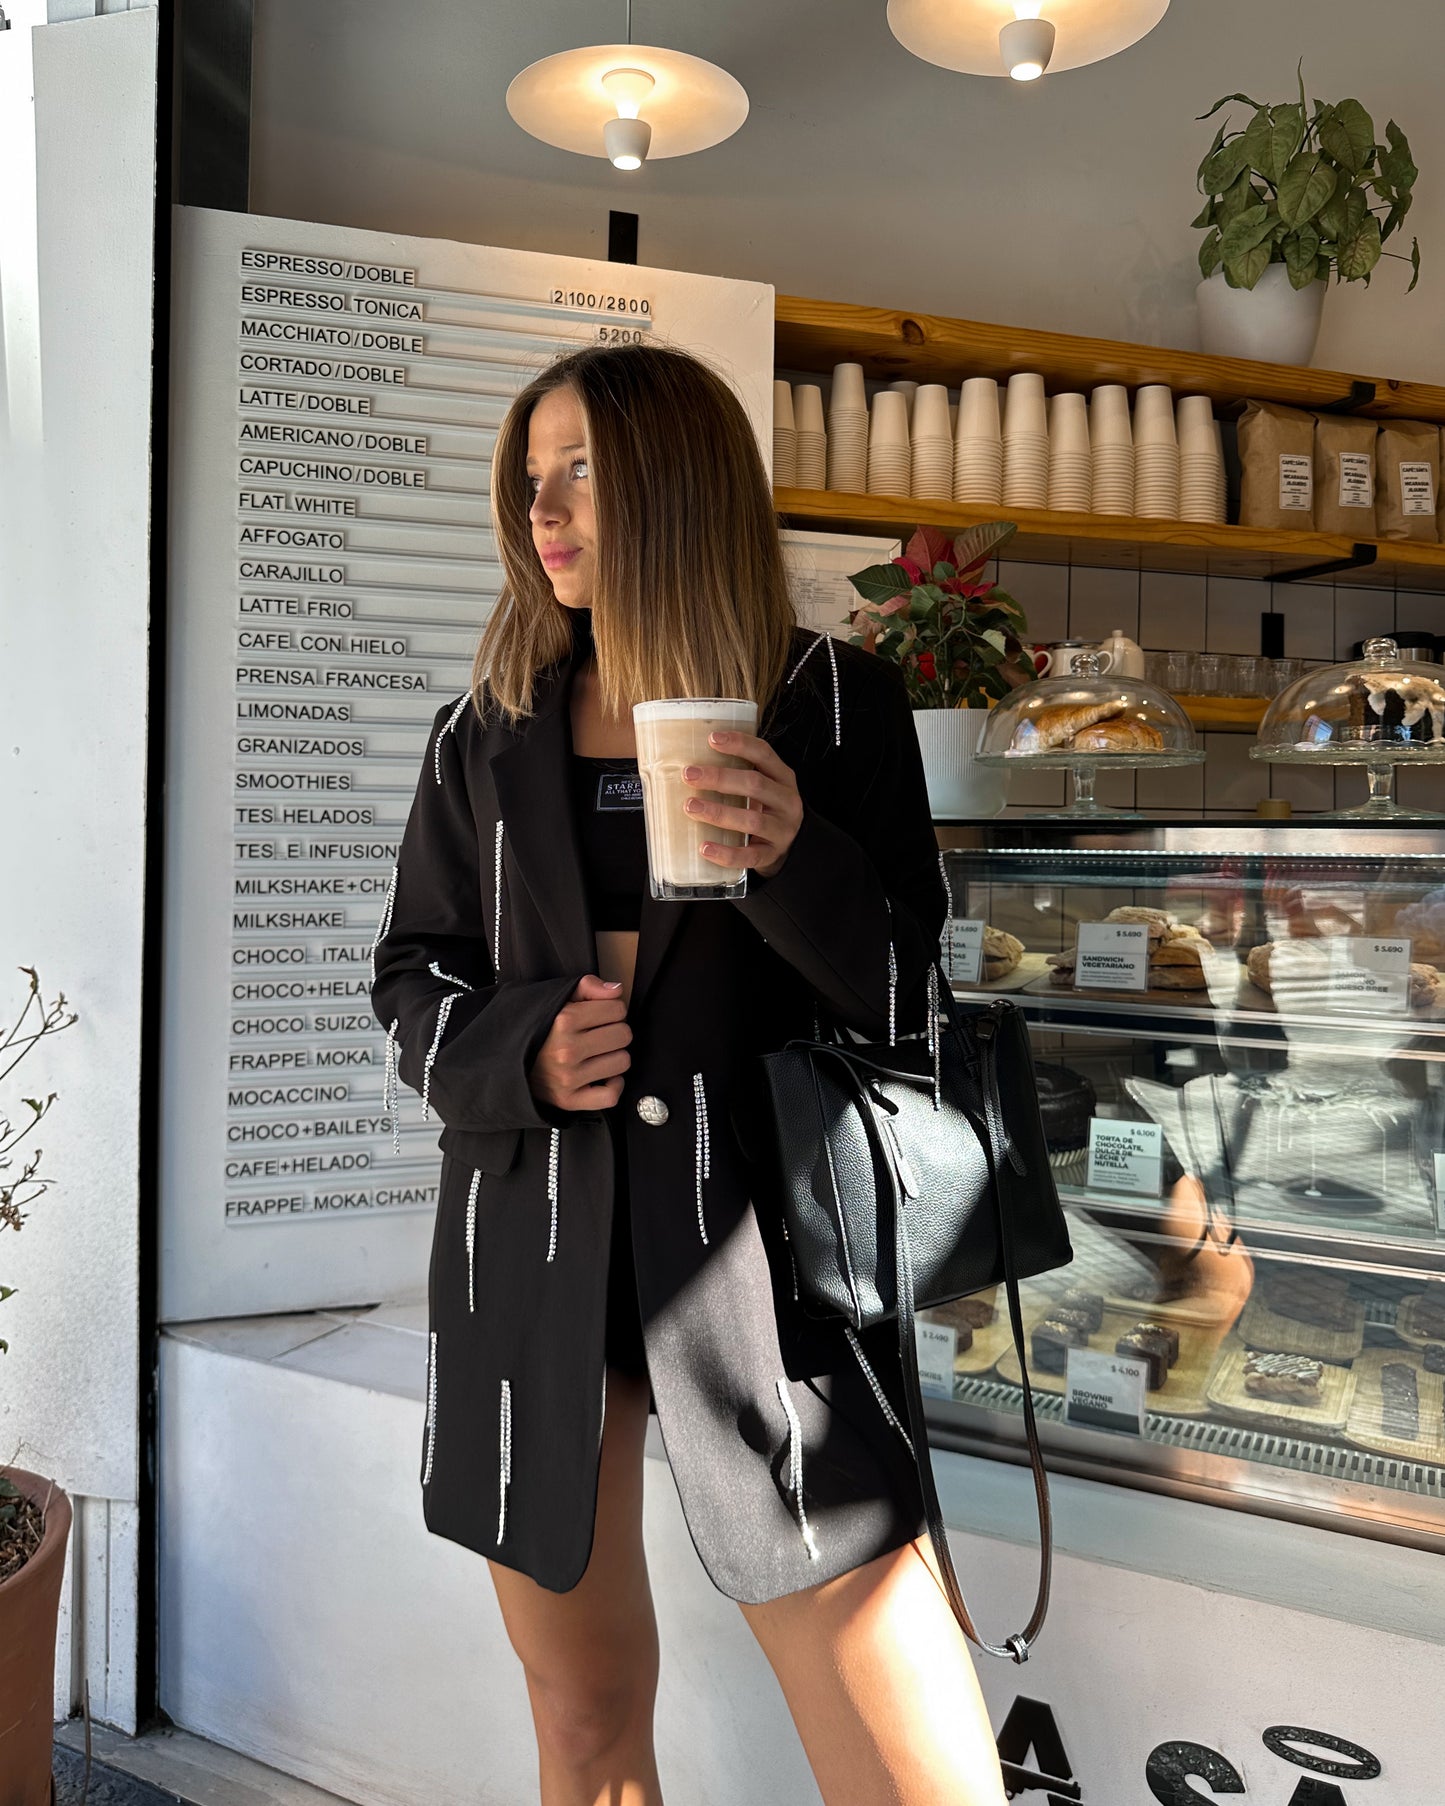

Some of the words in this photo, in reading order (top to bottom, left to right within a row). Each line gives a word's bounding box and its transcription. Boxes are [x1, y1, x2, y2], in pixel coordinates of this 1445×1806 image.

[241, 252, 414, 285] ESPRESSO/DOBLE
[241, 286, 343, 310] ESPRESSO
[353, 298, 421, 319] TONICA
[554, 290, 649, 313] 2100/2800
[241, 321, 422, 353] MACCHIATO/DOBLE
[600, 328, 641, 344] 5200
[241, 355, 404, 384] CORTADO/DOBLE
[240, 389, 369, 414] LATTE/DOBLE
[241, 424, 426, 454] AMERICANO/DOBLE
[240, 459, 424, 488] CAPUCHINO/DOBLE
[239, 493, 284, 510] FLAT
[295, 498, 355, 515] WHITE
[240, 528, 342, 548] AFFOGATO
[240, 563, 342, 583] CARAJILLO
[240, 598, 297, 614] LATTE
[308, 601, 351, 617] FRIO
[239, 633, 289, 649] CAFE
[301, 636, 341, 651] CON
[351, 639, 404, 655] HIELO
[237, 668, 315, 685] PRENSA
[326, 672, 425, 690] FRANCESA
[238, 703, 349, 720] LIMONADAS
[238, 738, 363, 756] GRANIZADOS
[236, 773, 350, 790] SMOOTHIES
[236, 808, 273, 823] TES
[283, 809, 372, 825] HELADOS
[236, 844, 273, 859] TES
[288, 844, 299, 858] E
[310, 844, 400, 859] INFUSION
[234, 913, 343, 928] MILKSHAKE
[233, 949, 304, 964] CHOCO
[233, 981, 372, 999] CHOCO+HELA
[233, 1018, 304, 1035] CHOCO
[314, 1015, 371, 1031] SUIZO
[230, 1052, 306, 1070] FRAPPE
[317, 1050, 371, 1065] MOKA
[228, 1086, 347, 1106] MOCACCINO
[228, 1118, 391, 1141] CHOCO+BAILEYS
[1096, 1134, 1120, 1142] TORTA
[225, 1153, 369, 1178] CAFE+HELADO
[1094, 1160, 1128, 1169] NUTELLA
[225, 1197, 302, 1217] FRAPPE
[314, 1192, 369, 1209] MOKA
[376, 1187, 438, 1204] CHANT
[919, 1369, 942, 1381] OKIES
[1072, 1388, 1113, 1404] BROWNIE
